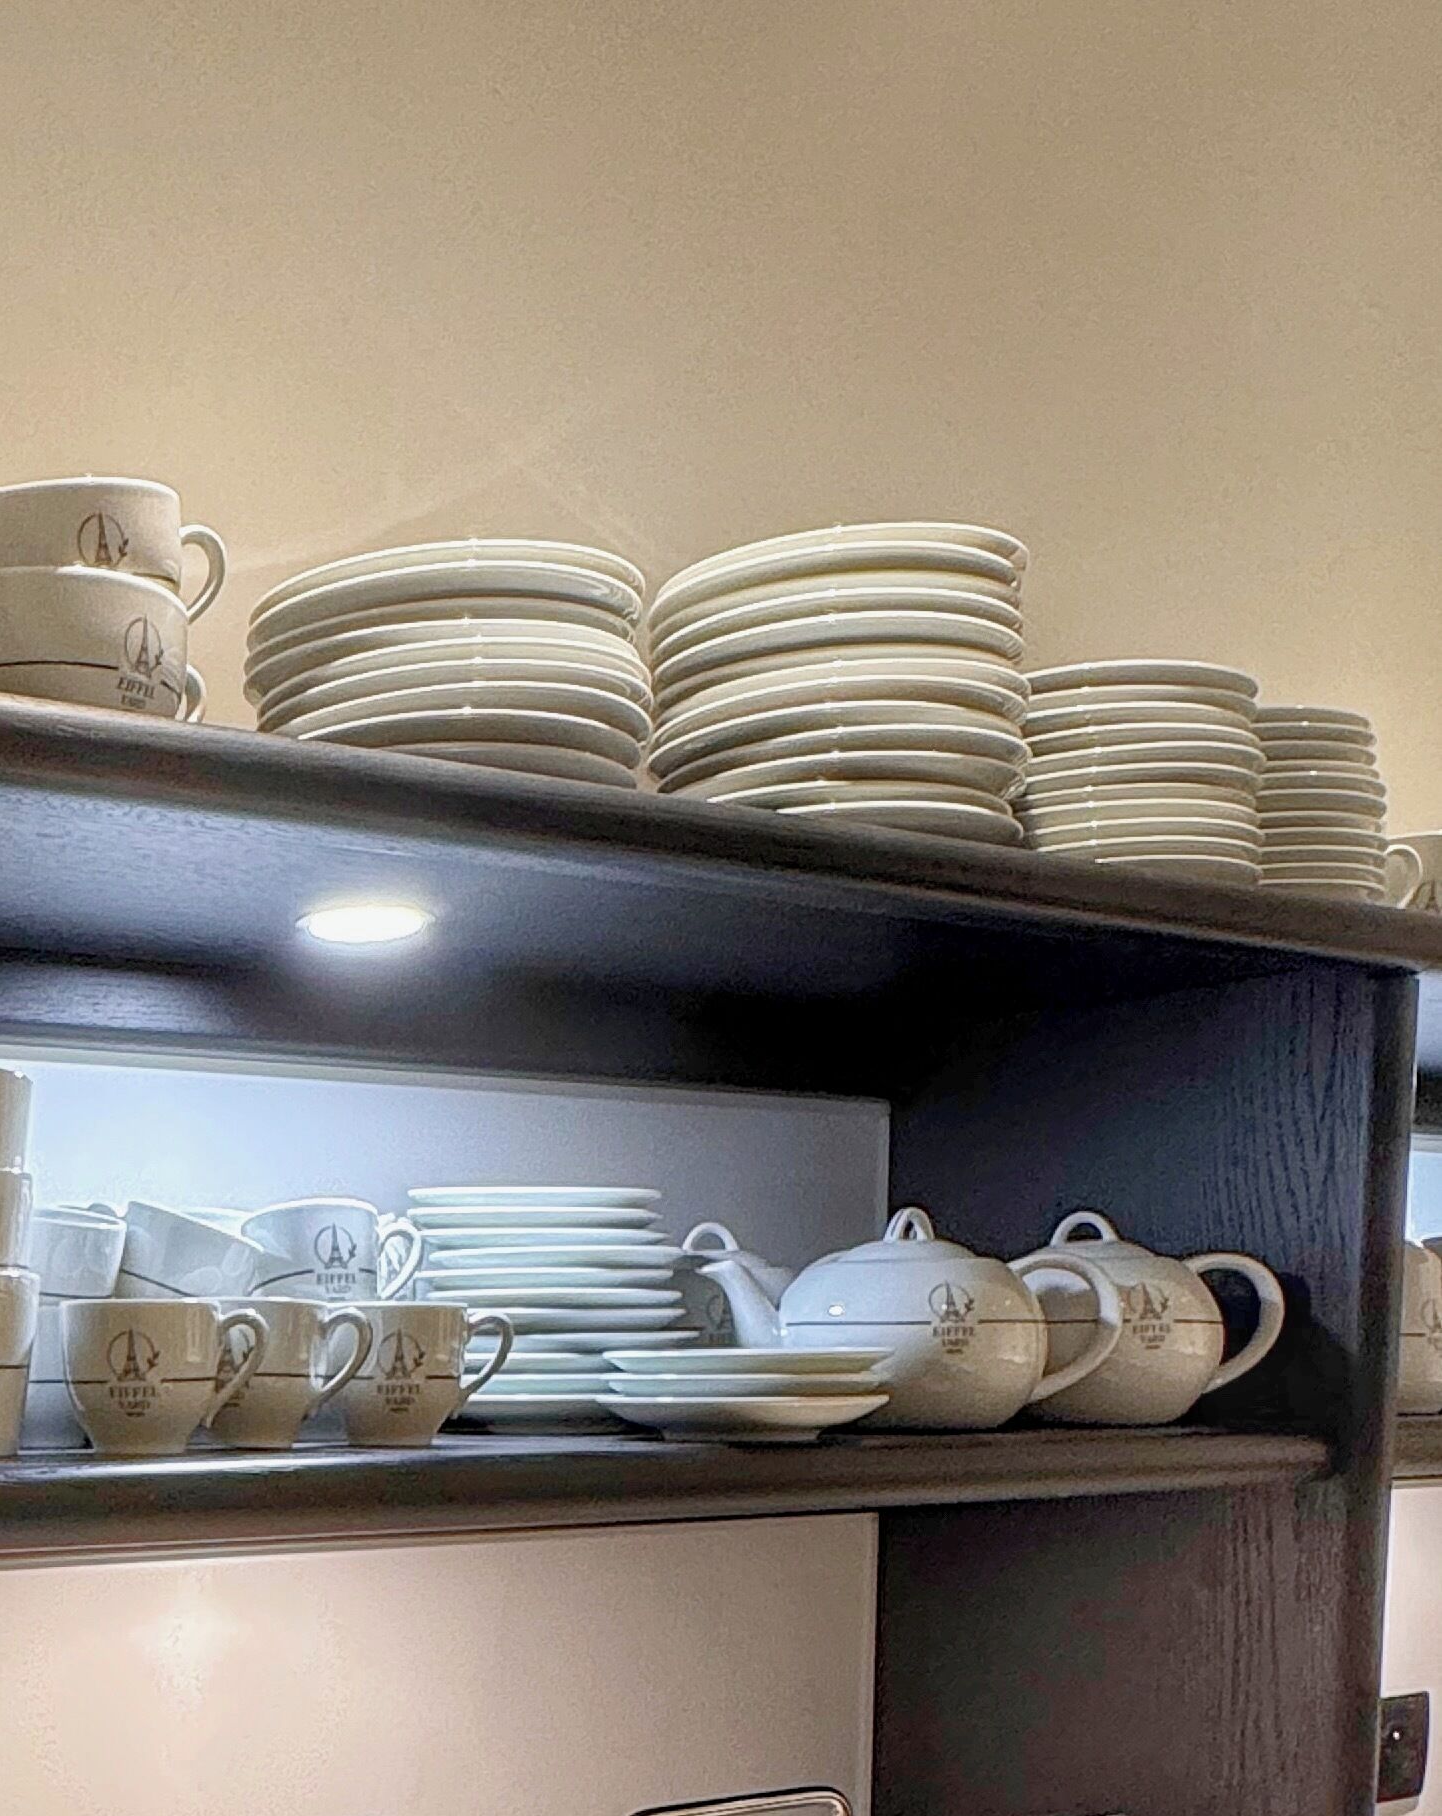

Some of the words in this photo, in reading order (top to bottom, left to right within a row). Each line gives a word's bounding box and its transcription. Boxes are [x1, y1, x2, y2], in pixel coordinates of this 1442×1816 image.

[117, 676, 155, 700] EIFFEL
[316, 1272, 357, 1286] EIFFEL
[109, 1385, 161, 1399] EIFFEL
